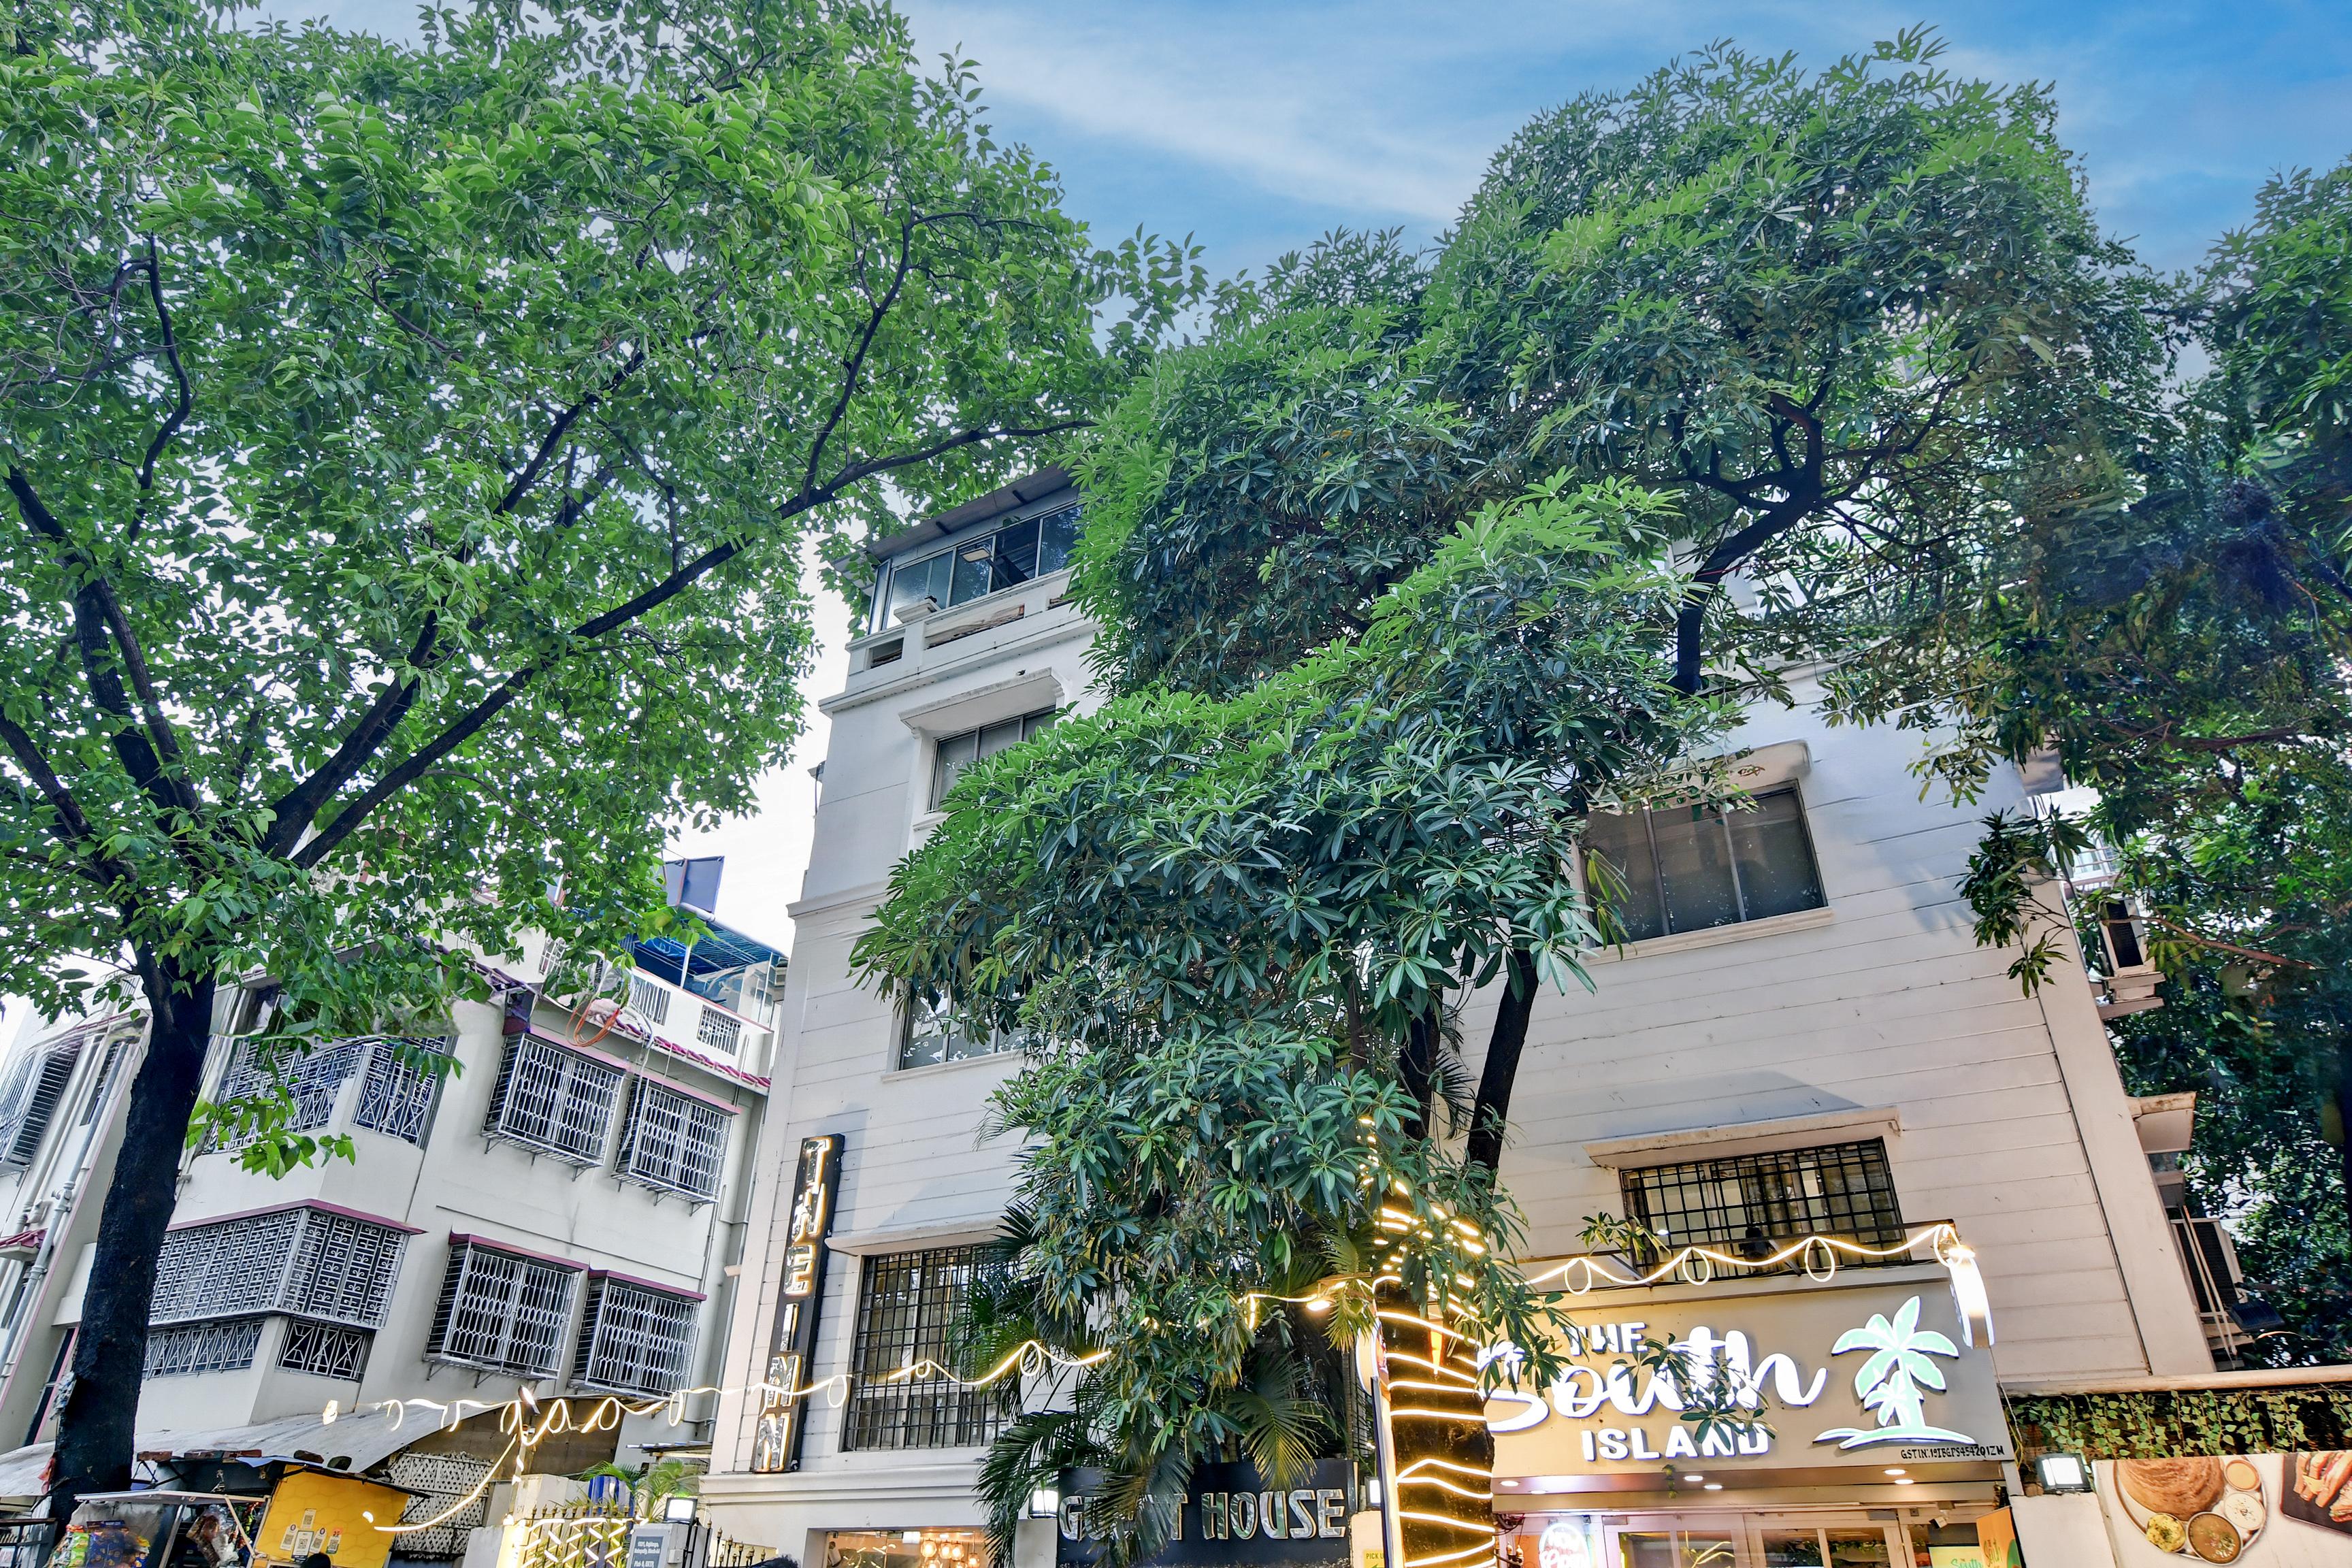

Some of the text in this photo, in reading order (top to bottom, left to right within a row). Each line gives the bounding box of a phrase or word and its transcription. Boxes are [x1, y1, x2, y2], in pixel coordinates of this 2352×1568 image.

[1561, 1322, 1648, 1356] THE
[754, 1303, 802, 1471] INN
[1477, 1326, 1828, 1433] South
[1582, 1425, 1769, 1461] ISLAND
[1201, 1488, 1348, 1541] HOUSE
